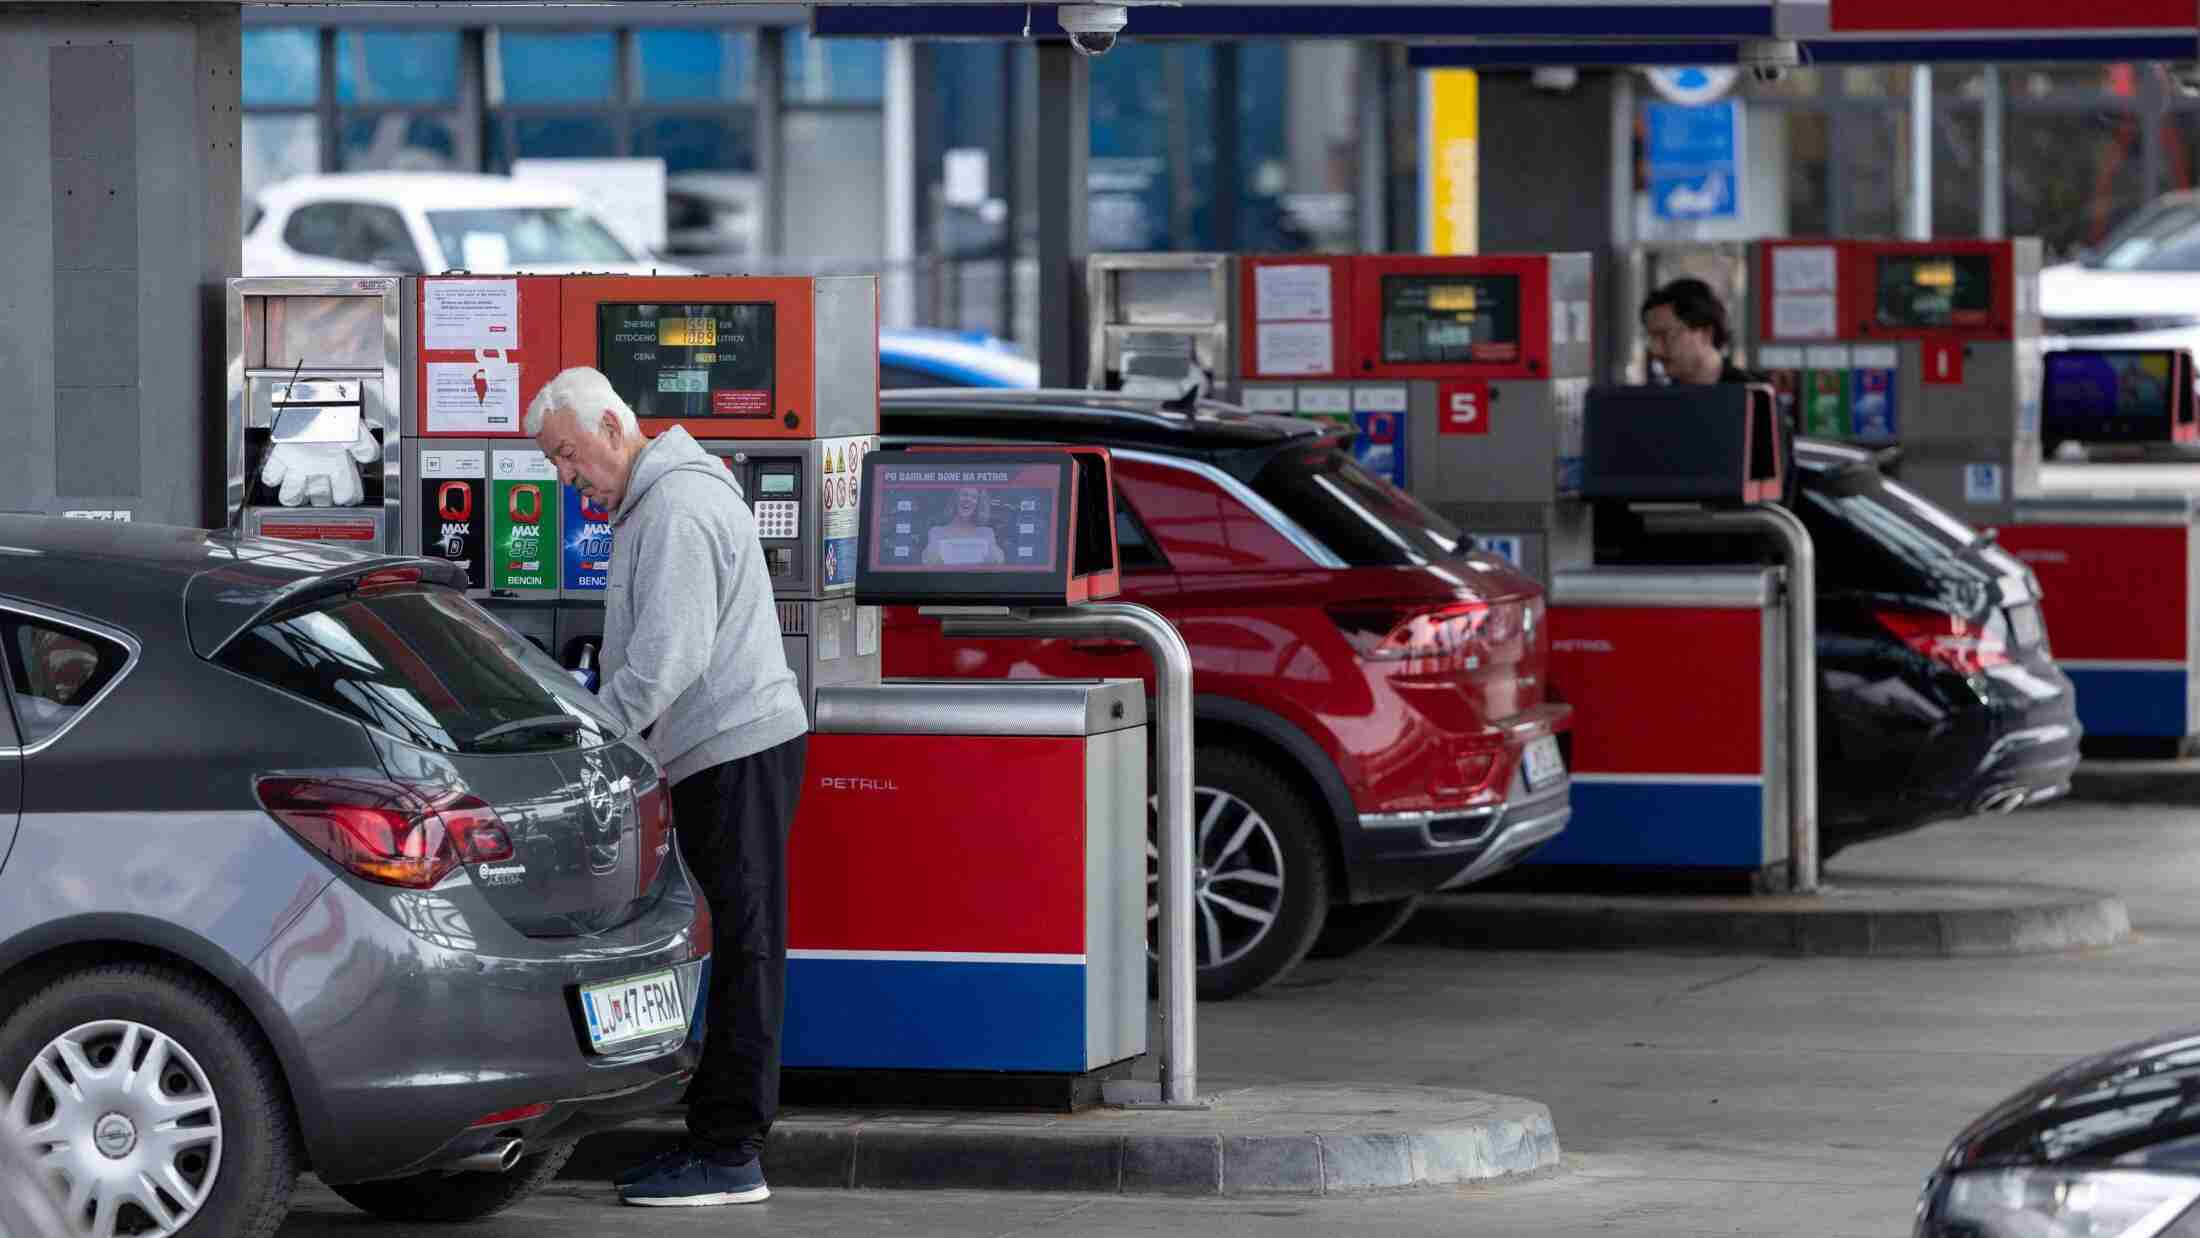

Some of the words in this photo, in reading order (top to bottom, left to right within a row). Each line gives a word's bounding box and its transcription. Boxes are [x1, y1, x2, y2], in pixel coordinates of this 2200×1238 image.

[1451, 392, 1478, 423] 5
[438, 481, 472, 520] Q
[509, 484, 542, 522] Q
[441, 523, 470, 535] MAX
[511, 525, 540, 537] MAX
[583, 523, 612, 535] MAX
[507, 577, 542, 585] BENCIN
